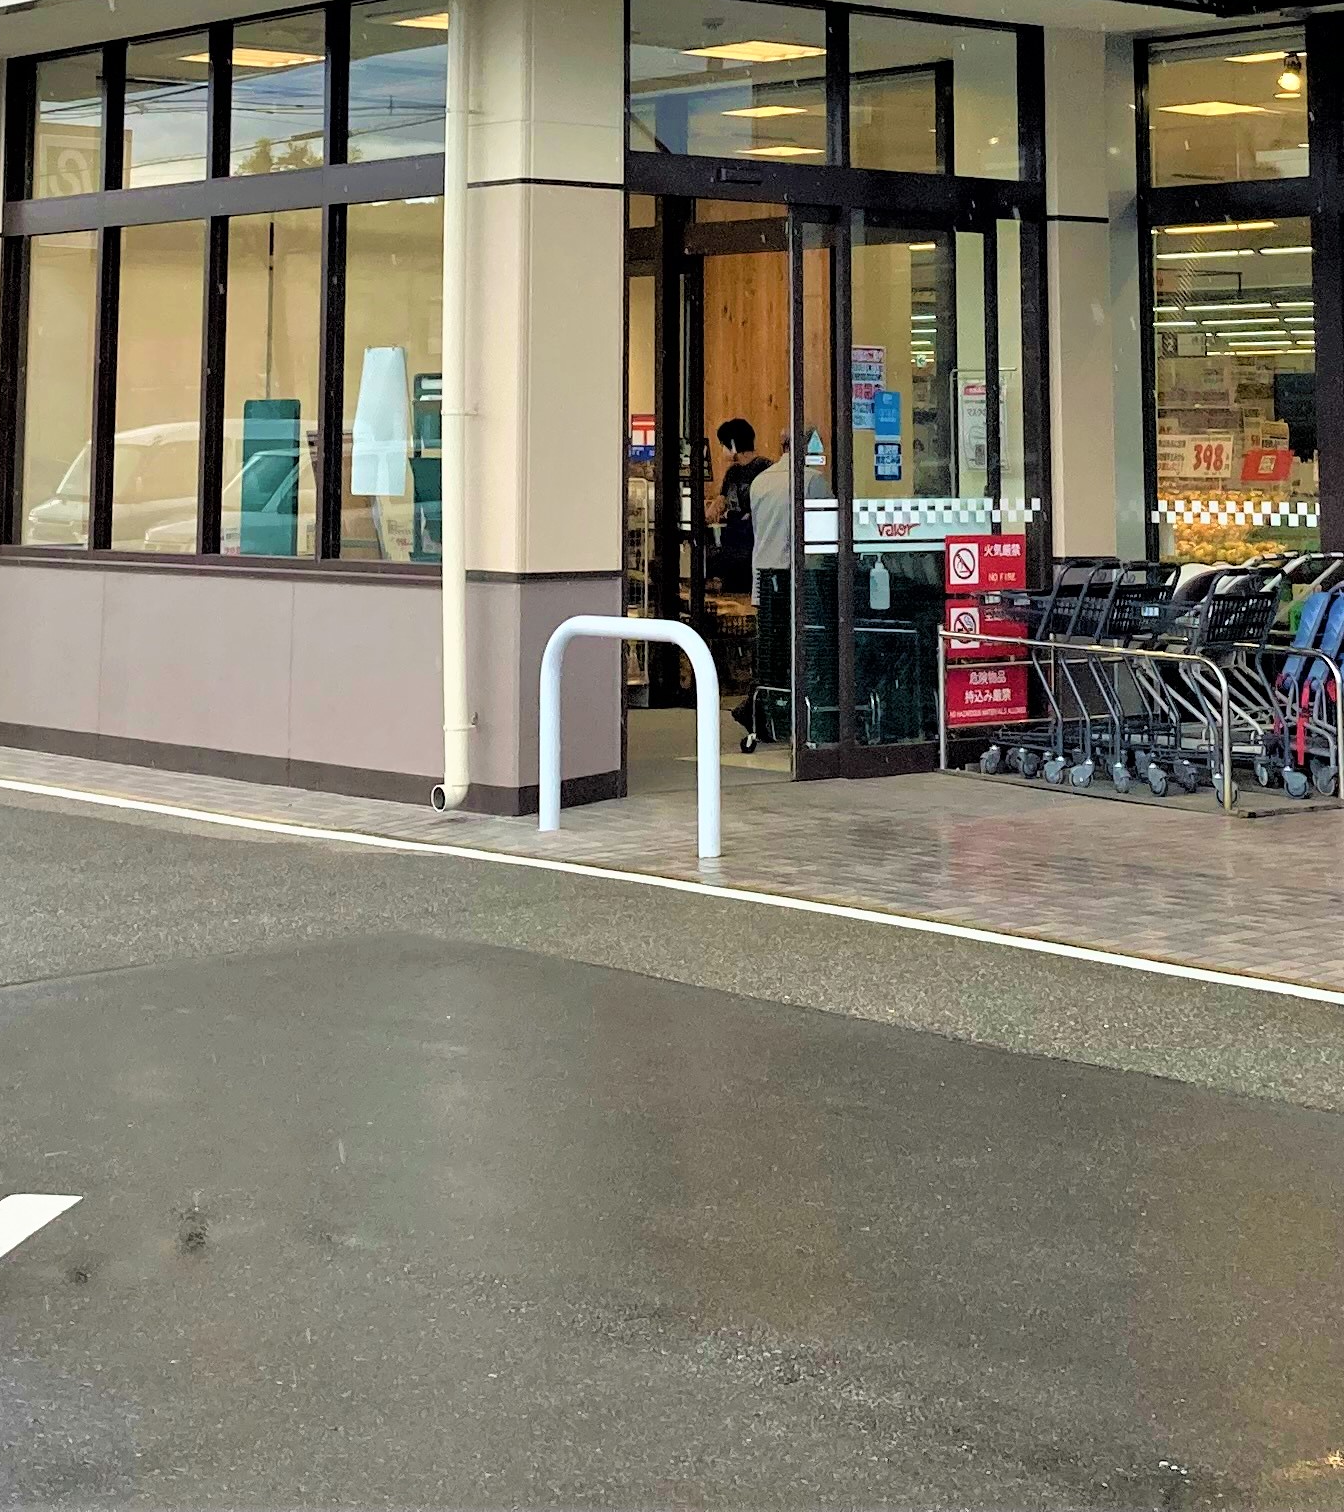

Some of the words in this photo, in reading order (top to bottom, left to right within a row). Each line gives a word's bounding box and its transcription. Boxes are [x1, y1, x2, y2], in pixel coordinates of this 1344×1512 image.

[1193, 443, 1224, 471] 398
[984, 544, 1021, 557] 火気厳禁
